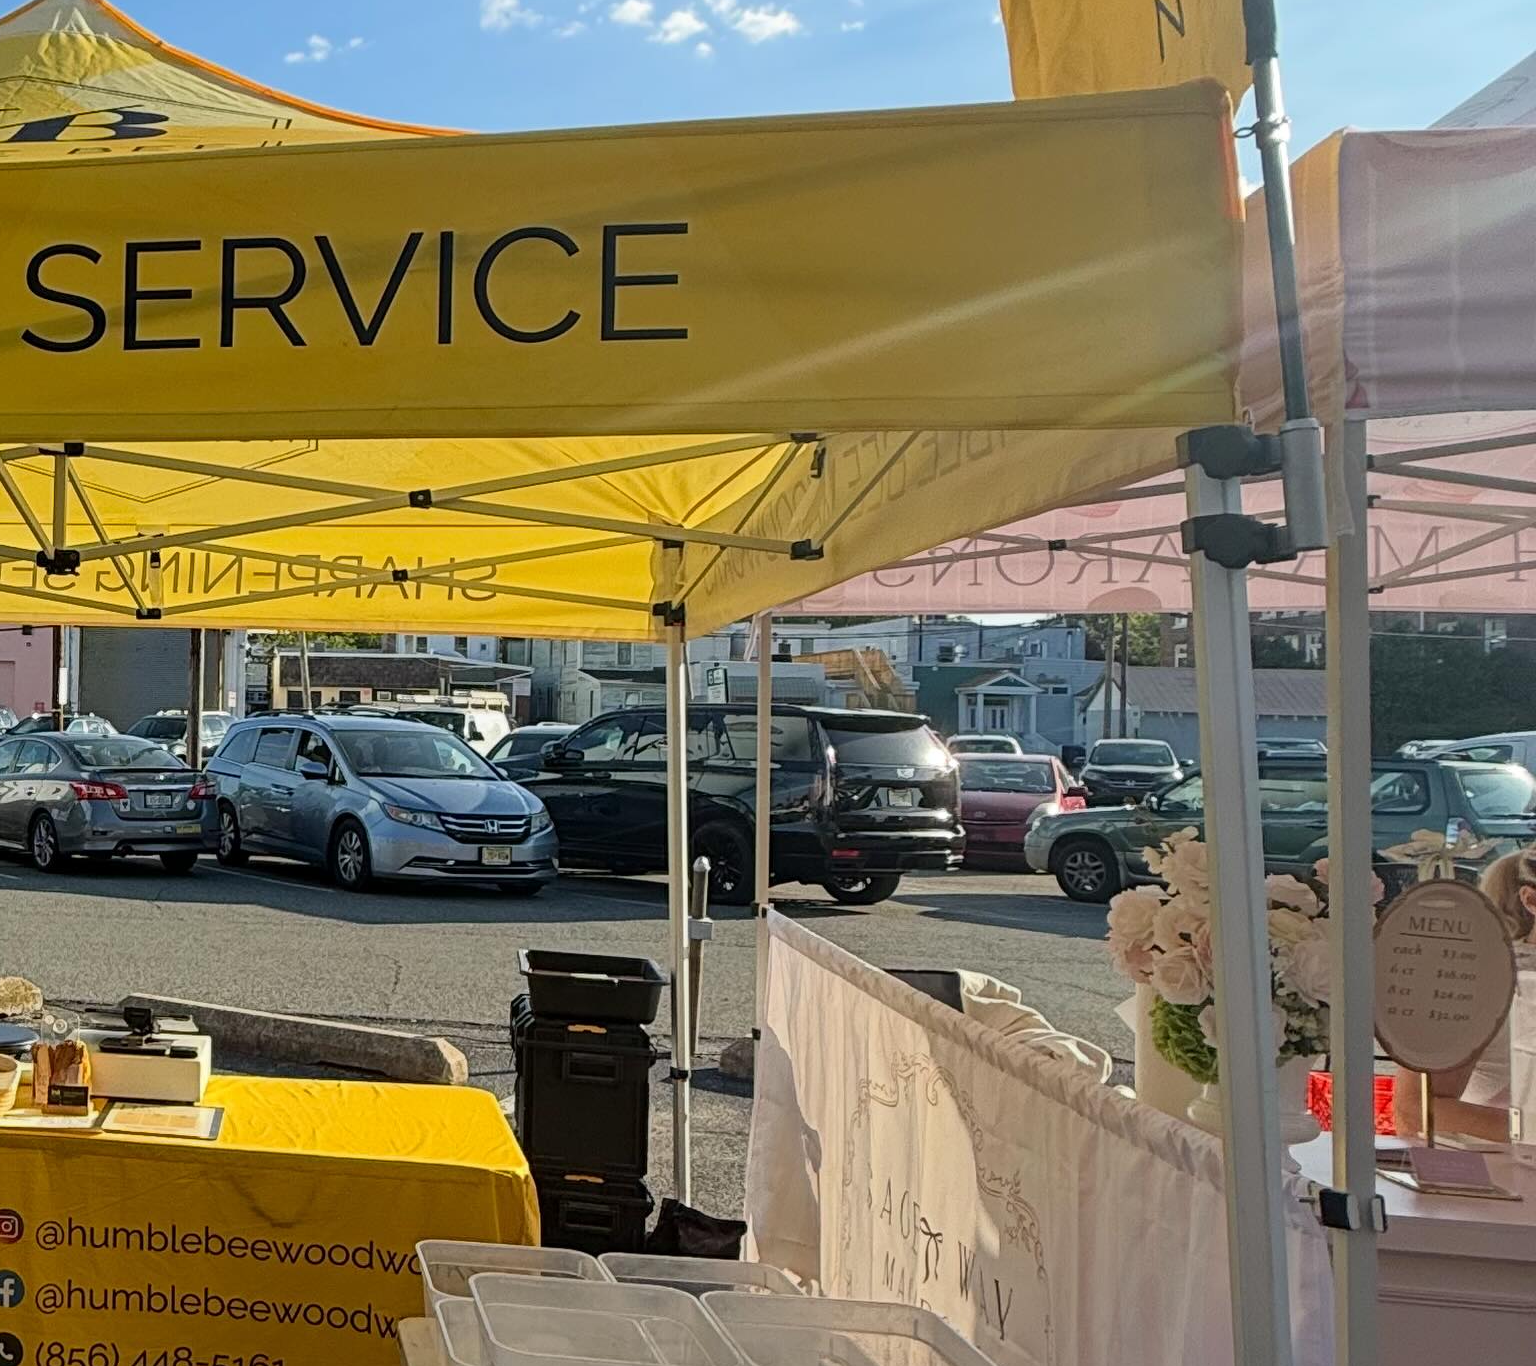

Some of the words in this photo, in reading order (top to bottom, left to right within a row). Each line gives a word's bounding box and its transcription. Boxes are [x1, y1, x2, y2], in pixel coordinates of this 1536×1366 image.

[23, 221, 691, 353] SERVICE
[1409, 916, 1472, 934] MENU
[35, 1217, 423, 1277] @humblebeewoodwo
[35, 1279, 399, 1339] @humblebeewoodw
